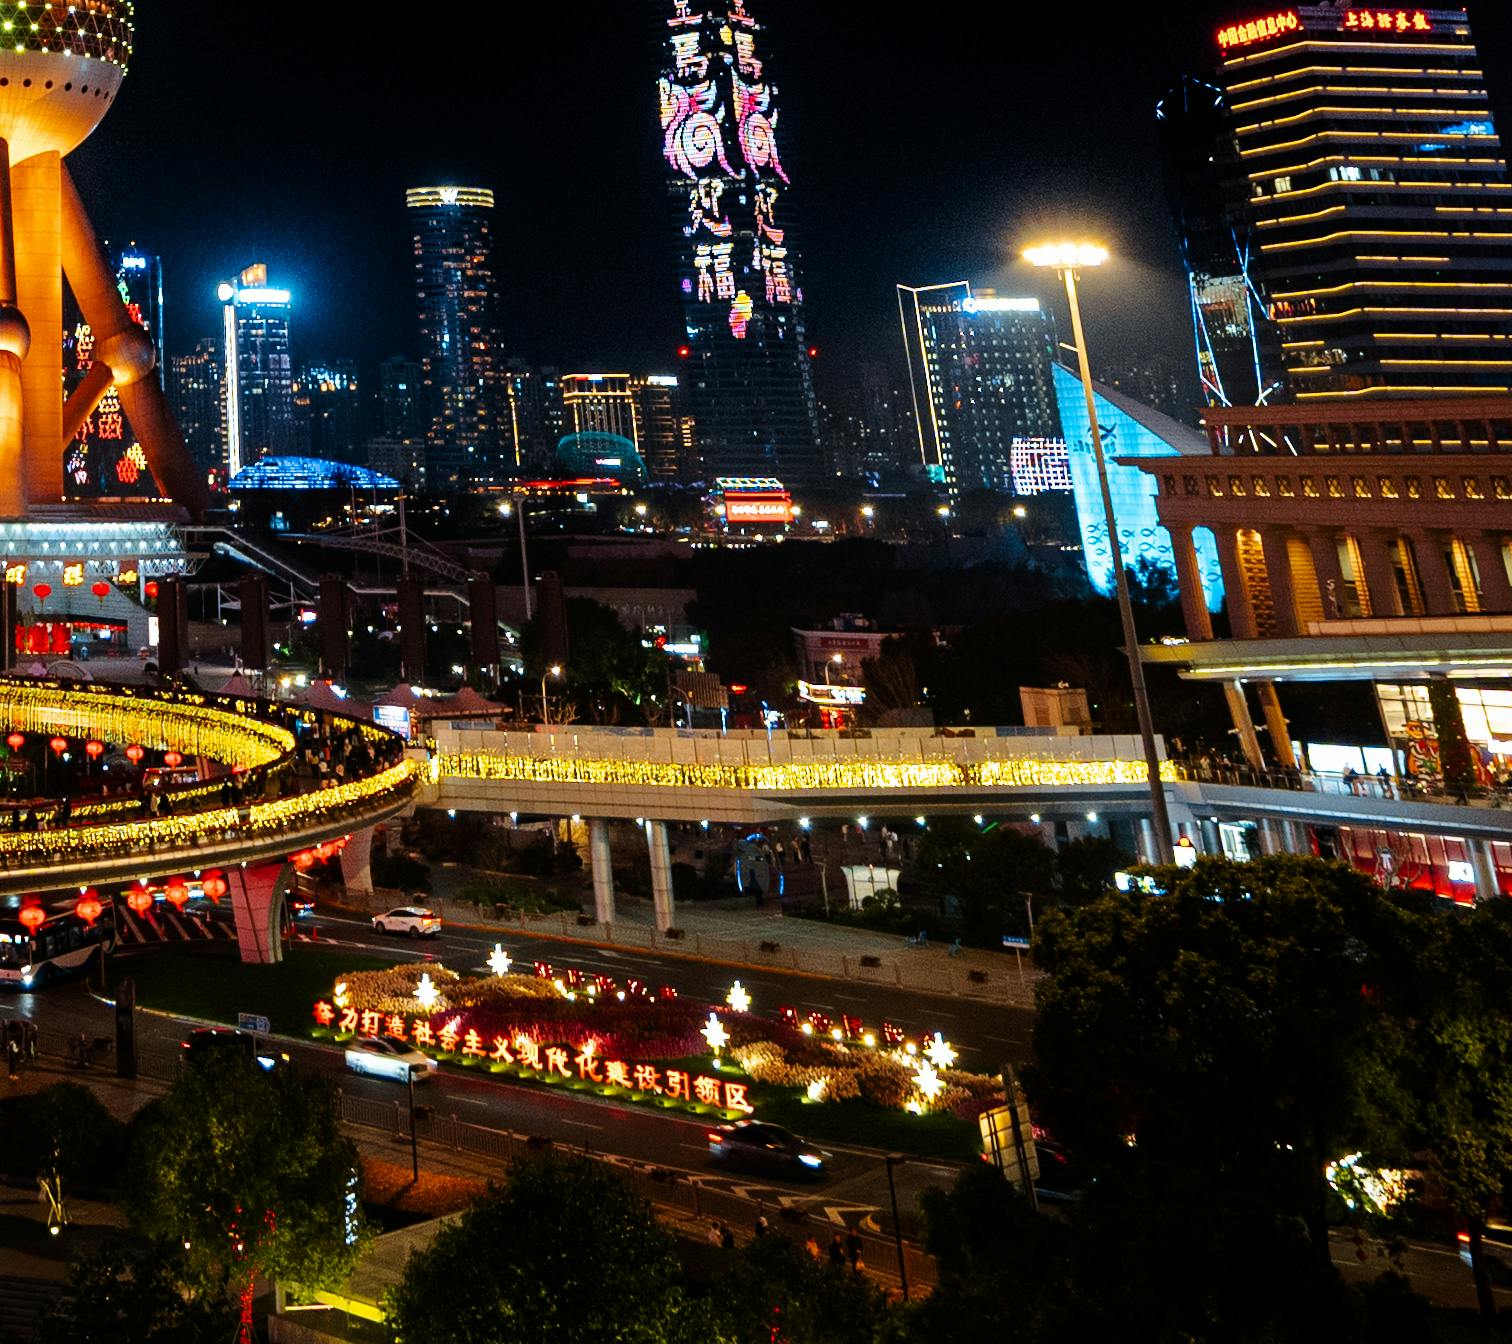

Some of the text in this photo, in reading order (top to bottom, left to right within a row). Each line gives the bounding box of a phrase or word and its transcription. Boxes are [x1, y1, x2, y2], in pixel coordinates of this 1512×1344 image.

[1218, 11, 1298, 48] 中国金融信息中心
